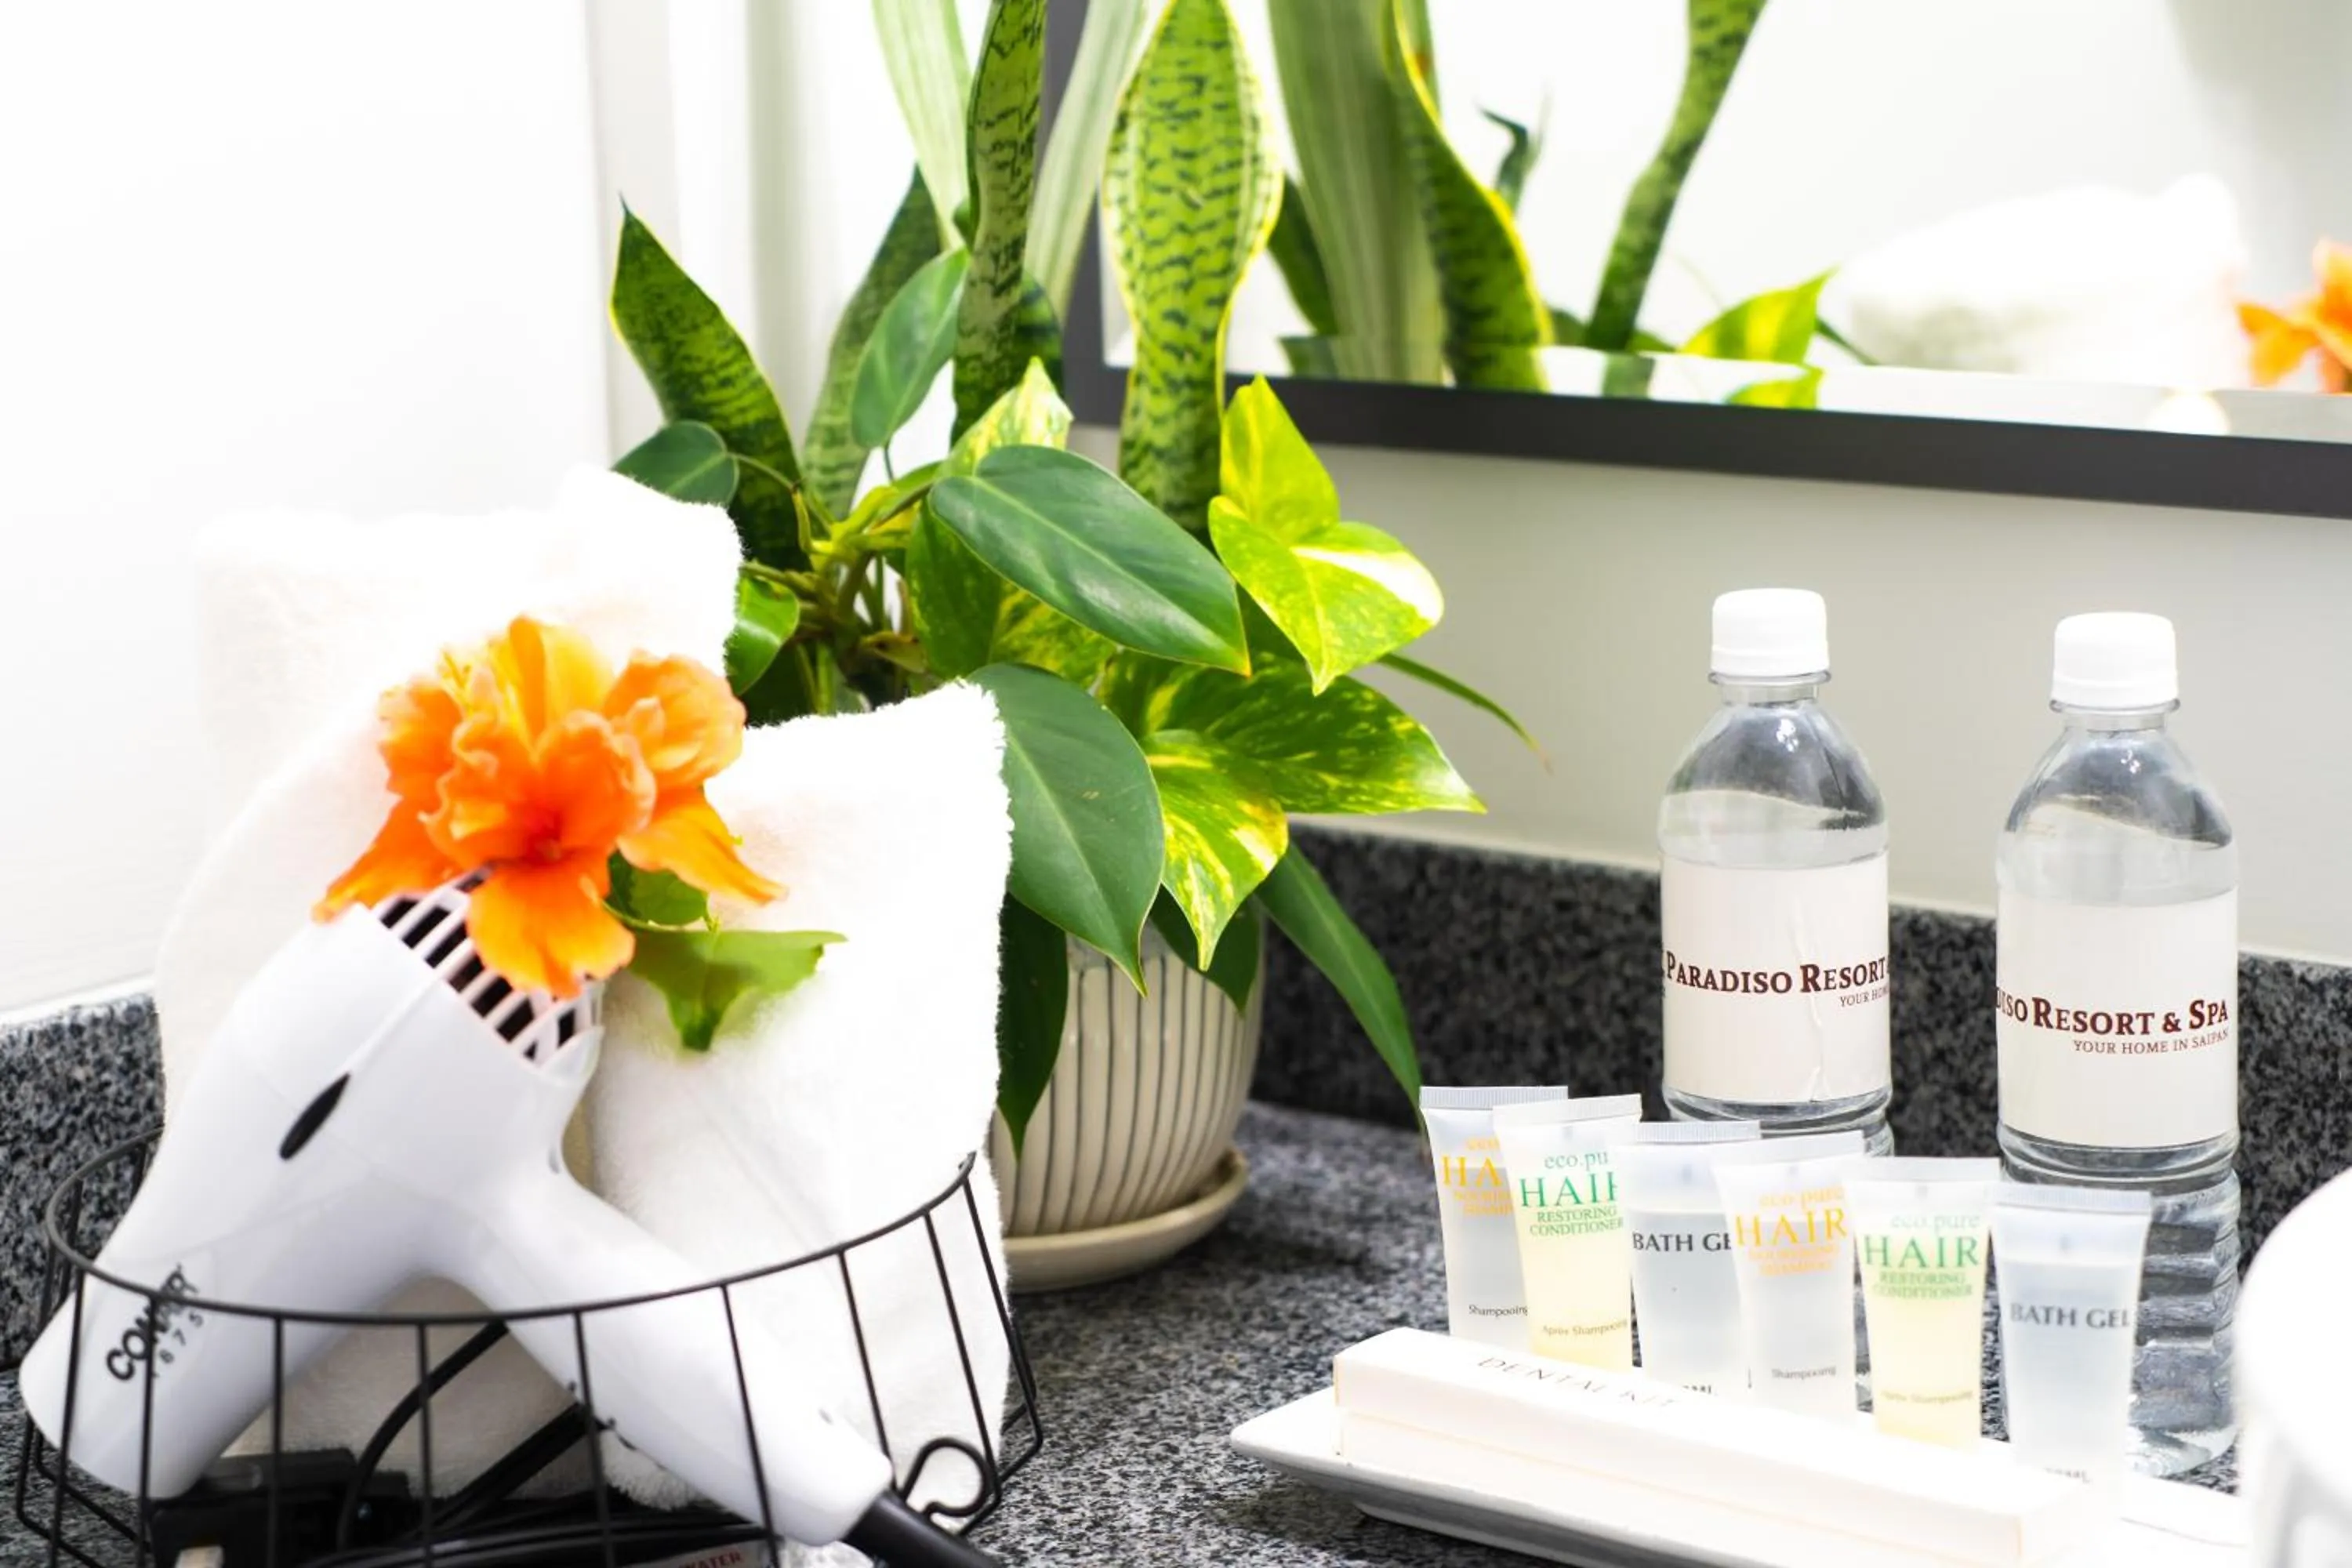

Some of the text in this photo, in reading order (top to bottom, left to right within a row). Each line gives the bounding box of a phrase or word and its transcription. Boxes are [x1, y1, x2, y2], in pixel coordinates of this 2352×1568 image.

[1666, 950, 1886, 994] PARADISO RESORT
[1840, 992, 1869, 1007] YOUR
[2032, 996, 2154, 1036] RESORT
[2162, 1012, 2182, 1033] &
[2189, 1000, 2228, 1029] SPA
[2074, 1028, 2230, 1054] YOUR HOME IN SAIPAN
[1442, 1156, 1503, 1187] HA
[1632, 1232, 1693, 1252] BATH
[1702, 1232, 1732, 1252] GE
[1735, 1207, 1847, 1247] HAIR
[1864, 1234, 1980, 1269] HAIR
[2010, 1302, 2130, 1330] BATH GEL
